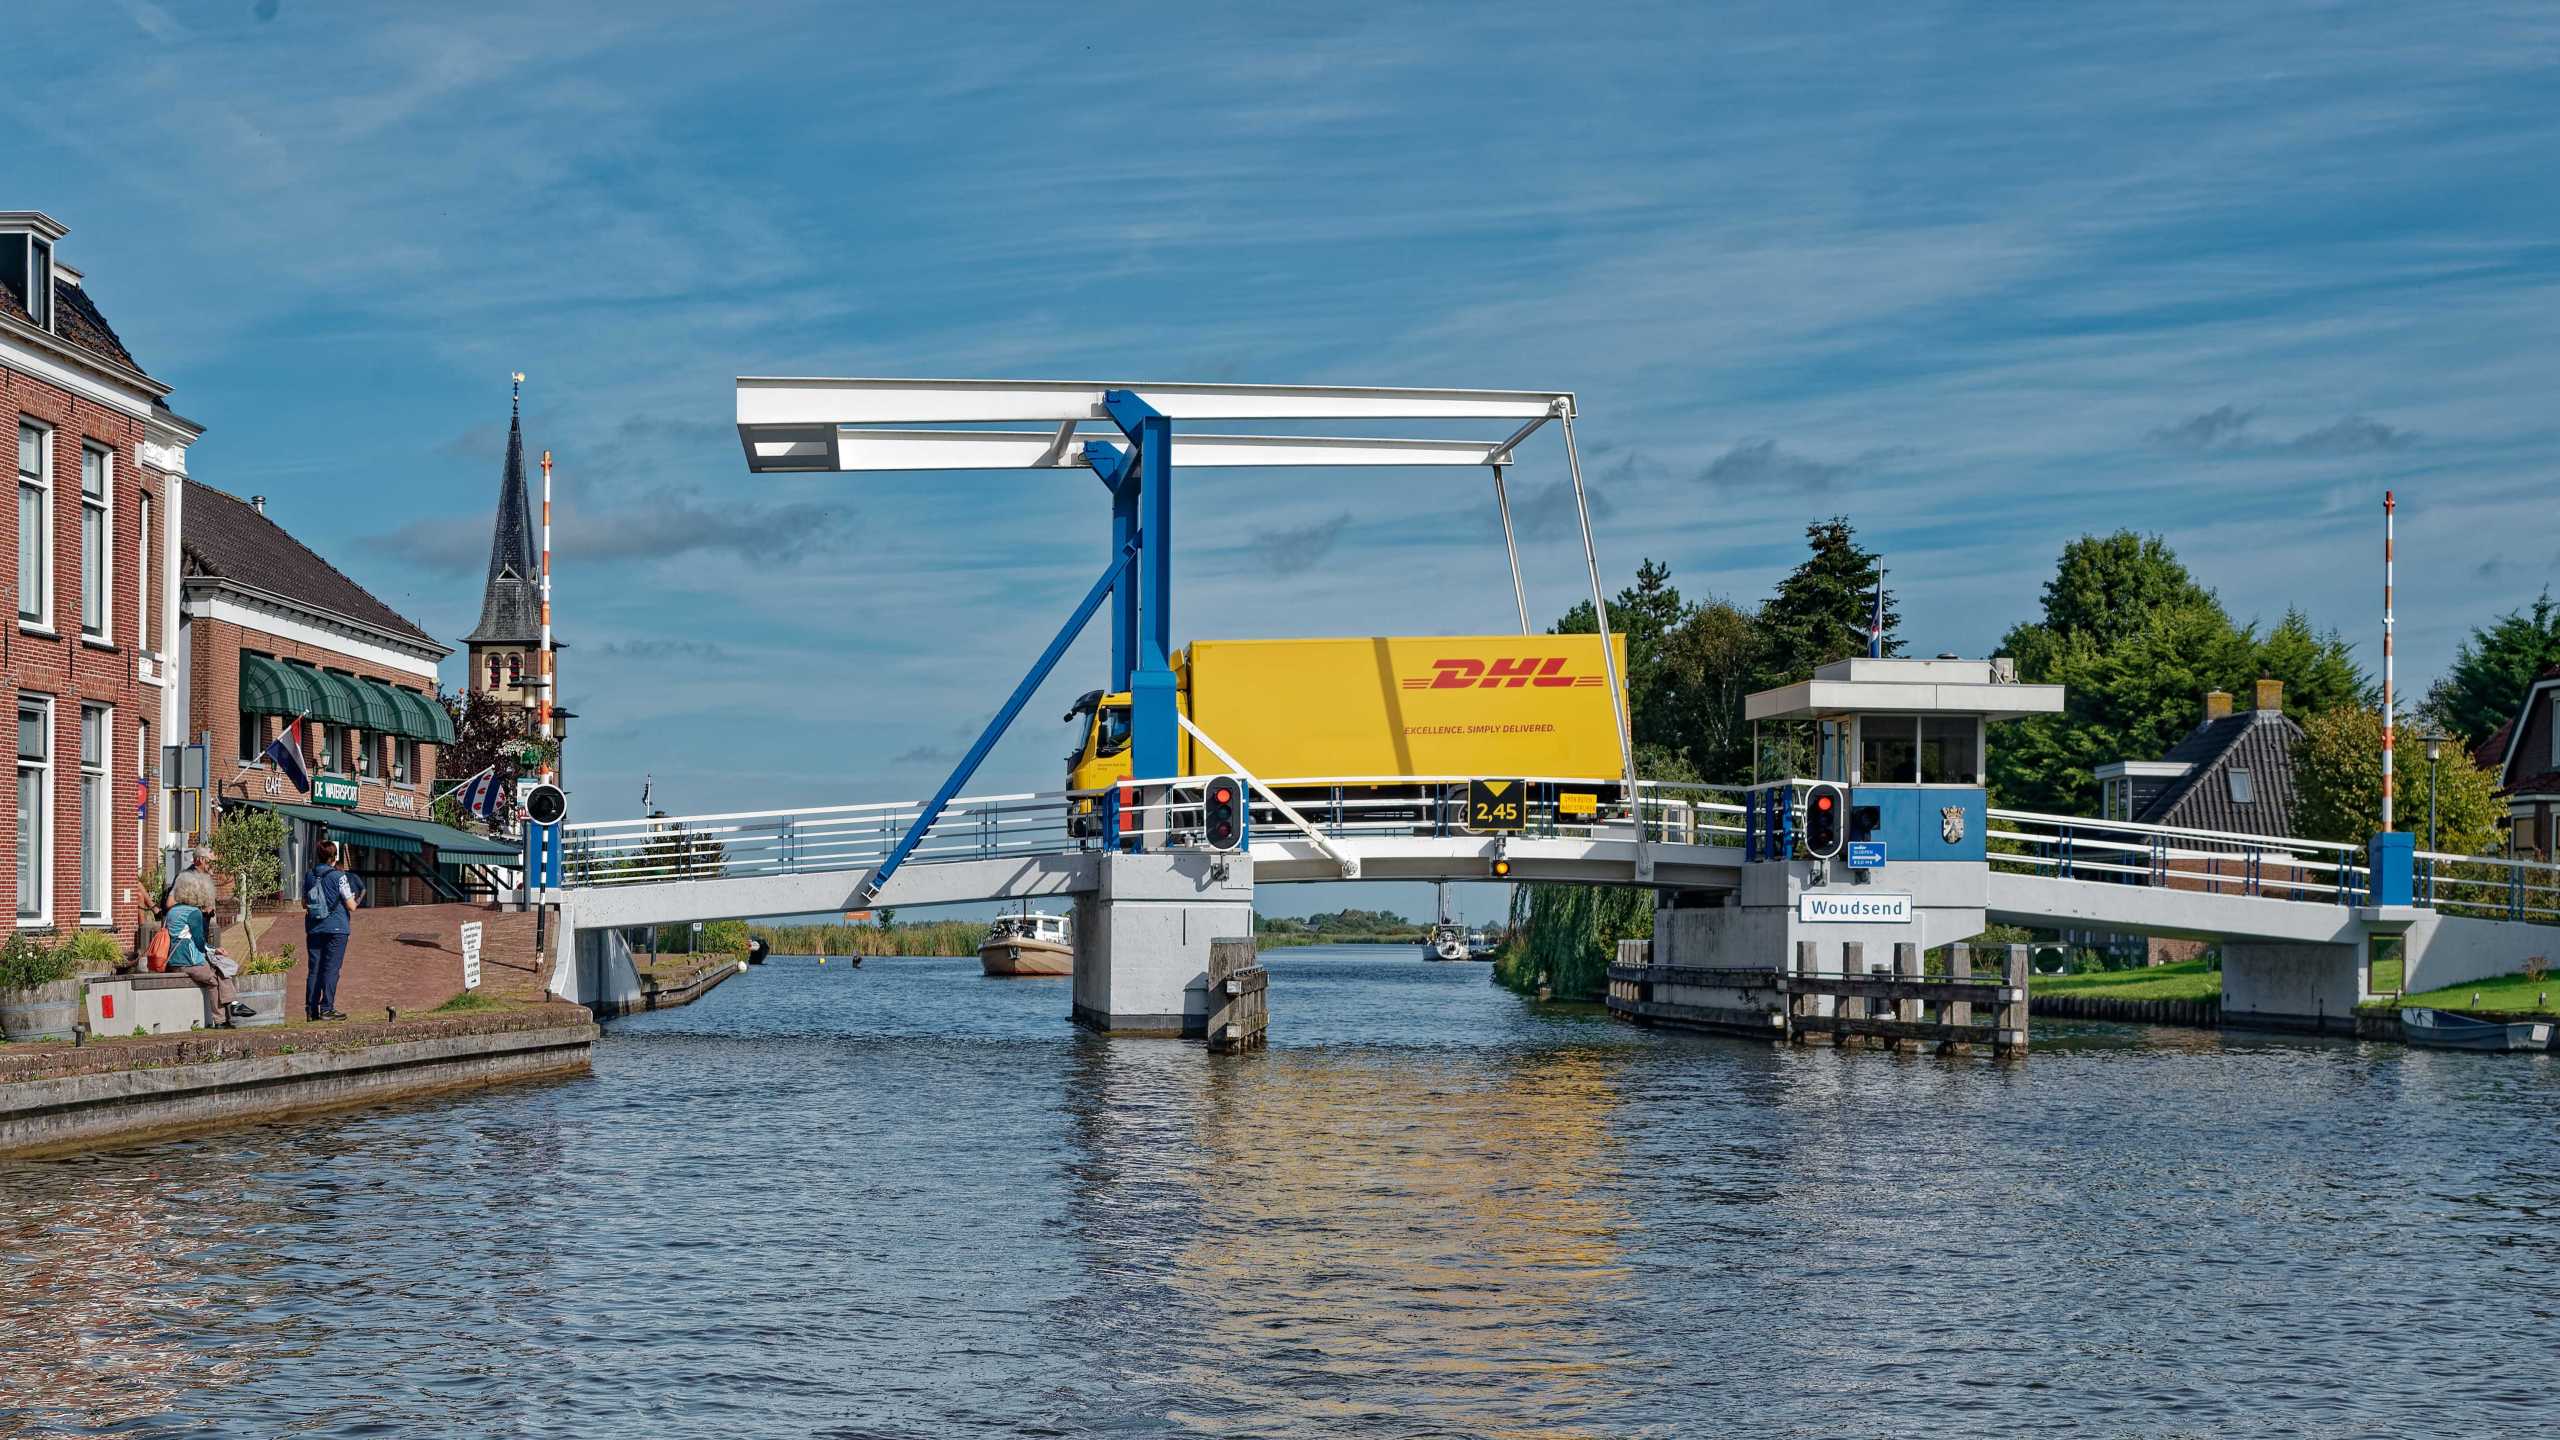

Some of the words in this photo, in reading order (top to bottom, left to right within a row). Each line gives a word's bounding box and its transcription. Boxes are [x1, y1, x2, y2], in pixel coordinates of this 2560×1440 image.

[1430, 657, 1577, 689] DHL
[1403, 725, 1465, 735] EXCELLENCE.
[1467, 724, 1501, 734] SIMPLY
[1503, 723, 1556, 733] DELIVERED.
[314, 781, 324, 797] DE
[325, 783, 358, 802] WATERSPORT
[1476, 803, 1518, 822] 2,45
[1811, 901, 1903, 916] Woudsend
